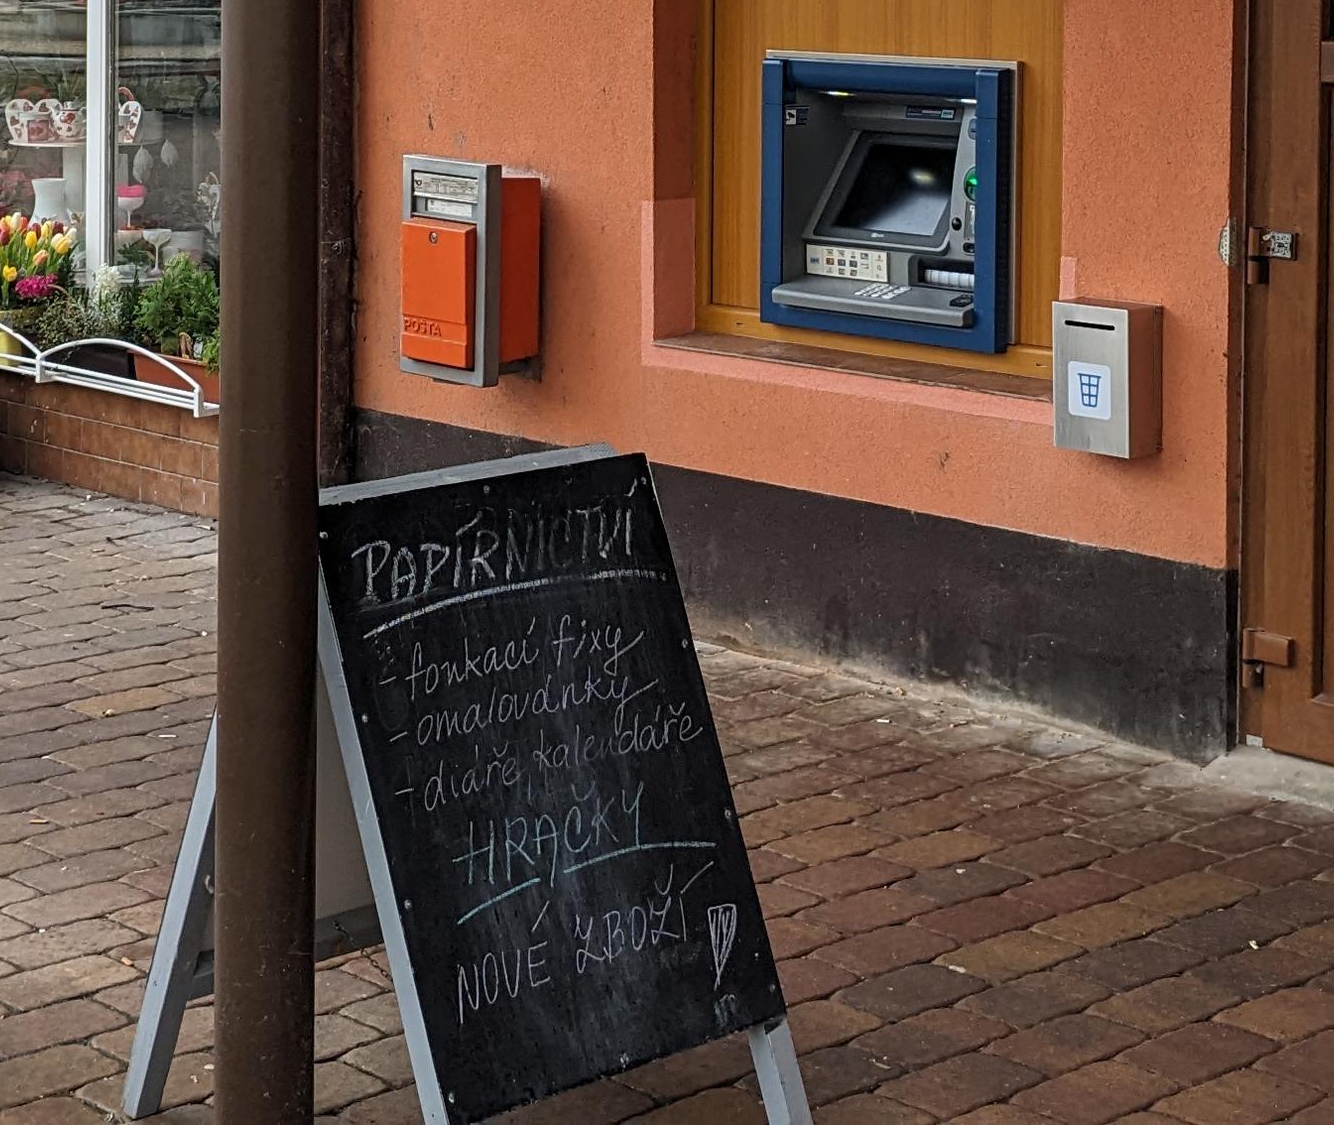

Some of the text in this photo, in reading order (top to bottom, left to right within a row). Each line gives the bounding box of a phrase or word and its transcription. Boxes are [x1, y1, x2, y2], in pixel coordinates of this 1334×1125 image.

[403, 316, 443, 338] POŠTA
[351, 478, 639, 603] PAPÍRNICTVÍ
[552, 614, 644, 675] fixy
[417, 666, 659, 746] omalovánky
[452, 780, 647, 888] HRAČKY
[457, 900, 552, 1024] NOVÉ
[573, 861, 715, 975] ZBOŽÍ
